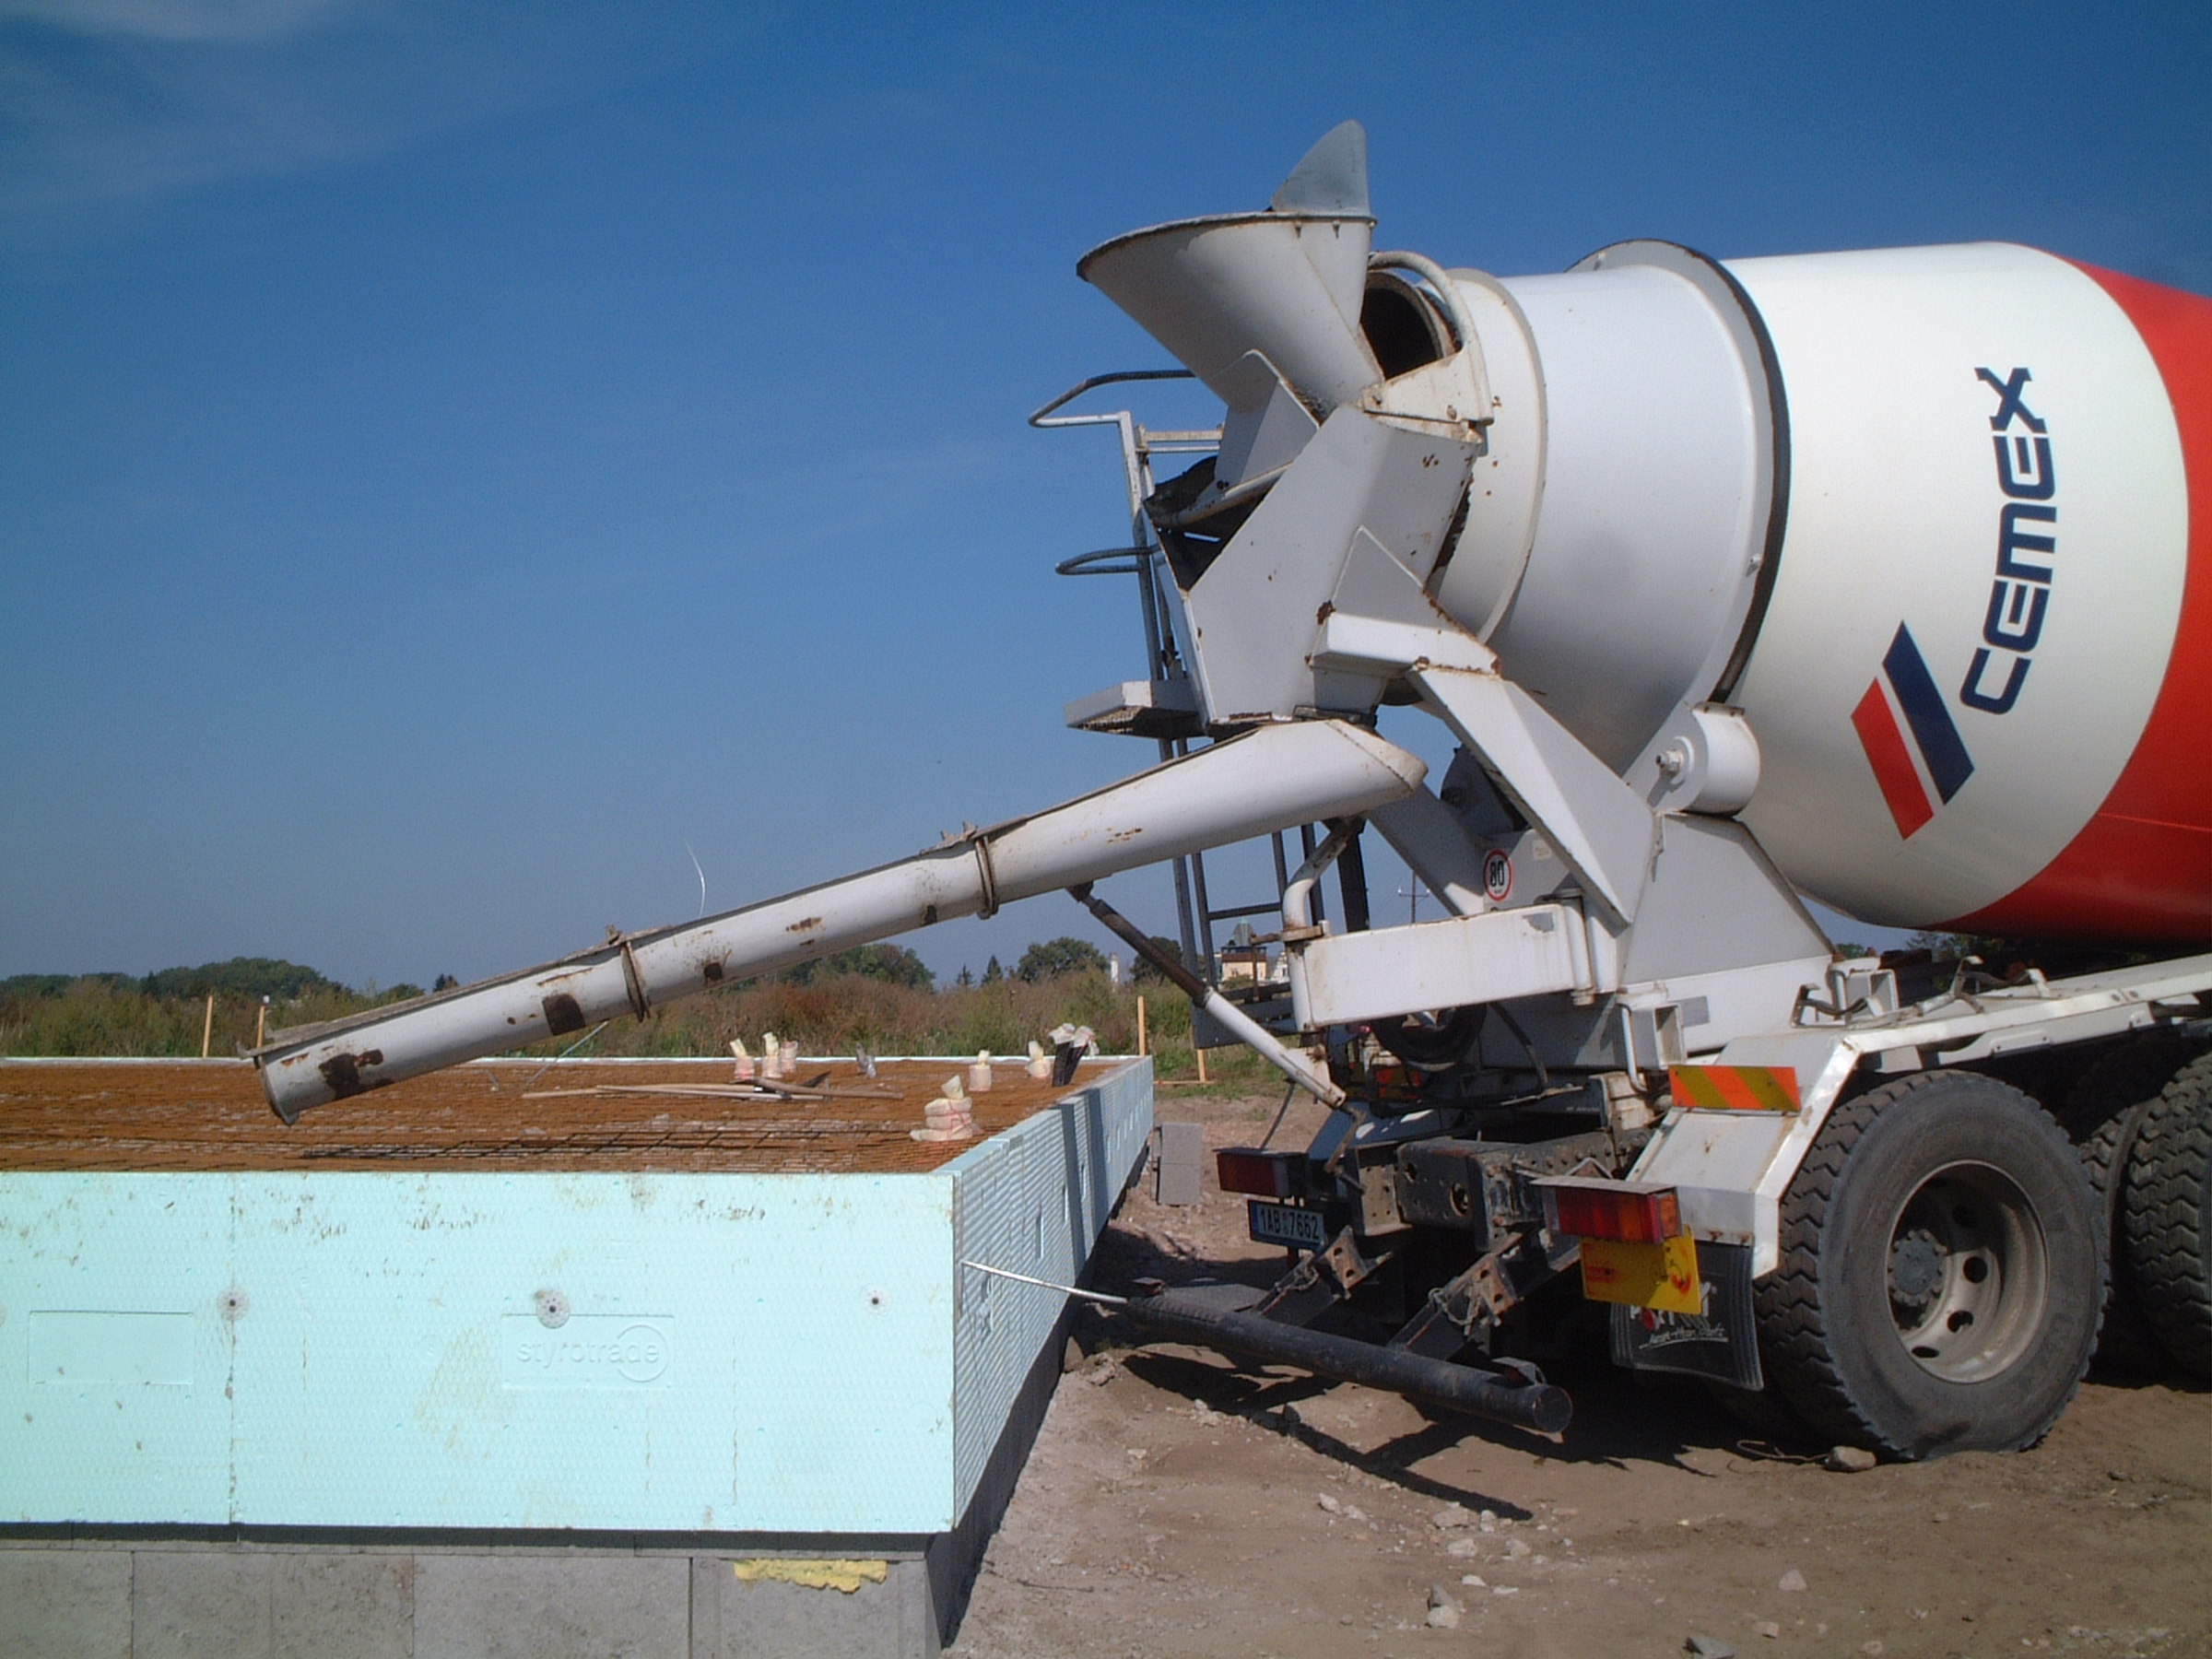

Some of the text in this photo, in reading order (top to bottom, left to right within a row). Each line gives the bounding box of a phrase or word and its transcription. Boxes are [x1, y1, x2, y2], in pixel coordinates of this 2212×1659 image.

[1959, 367, 2057, 715] CEMEX
[1489, 860, 1505, 887] 80
[516, 1339, 661, 1369] styrotrade
